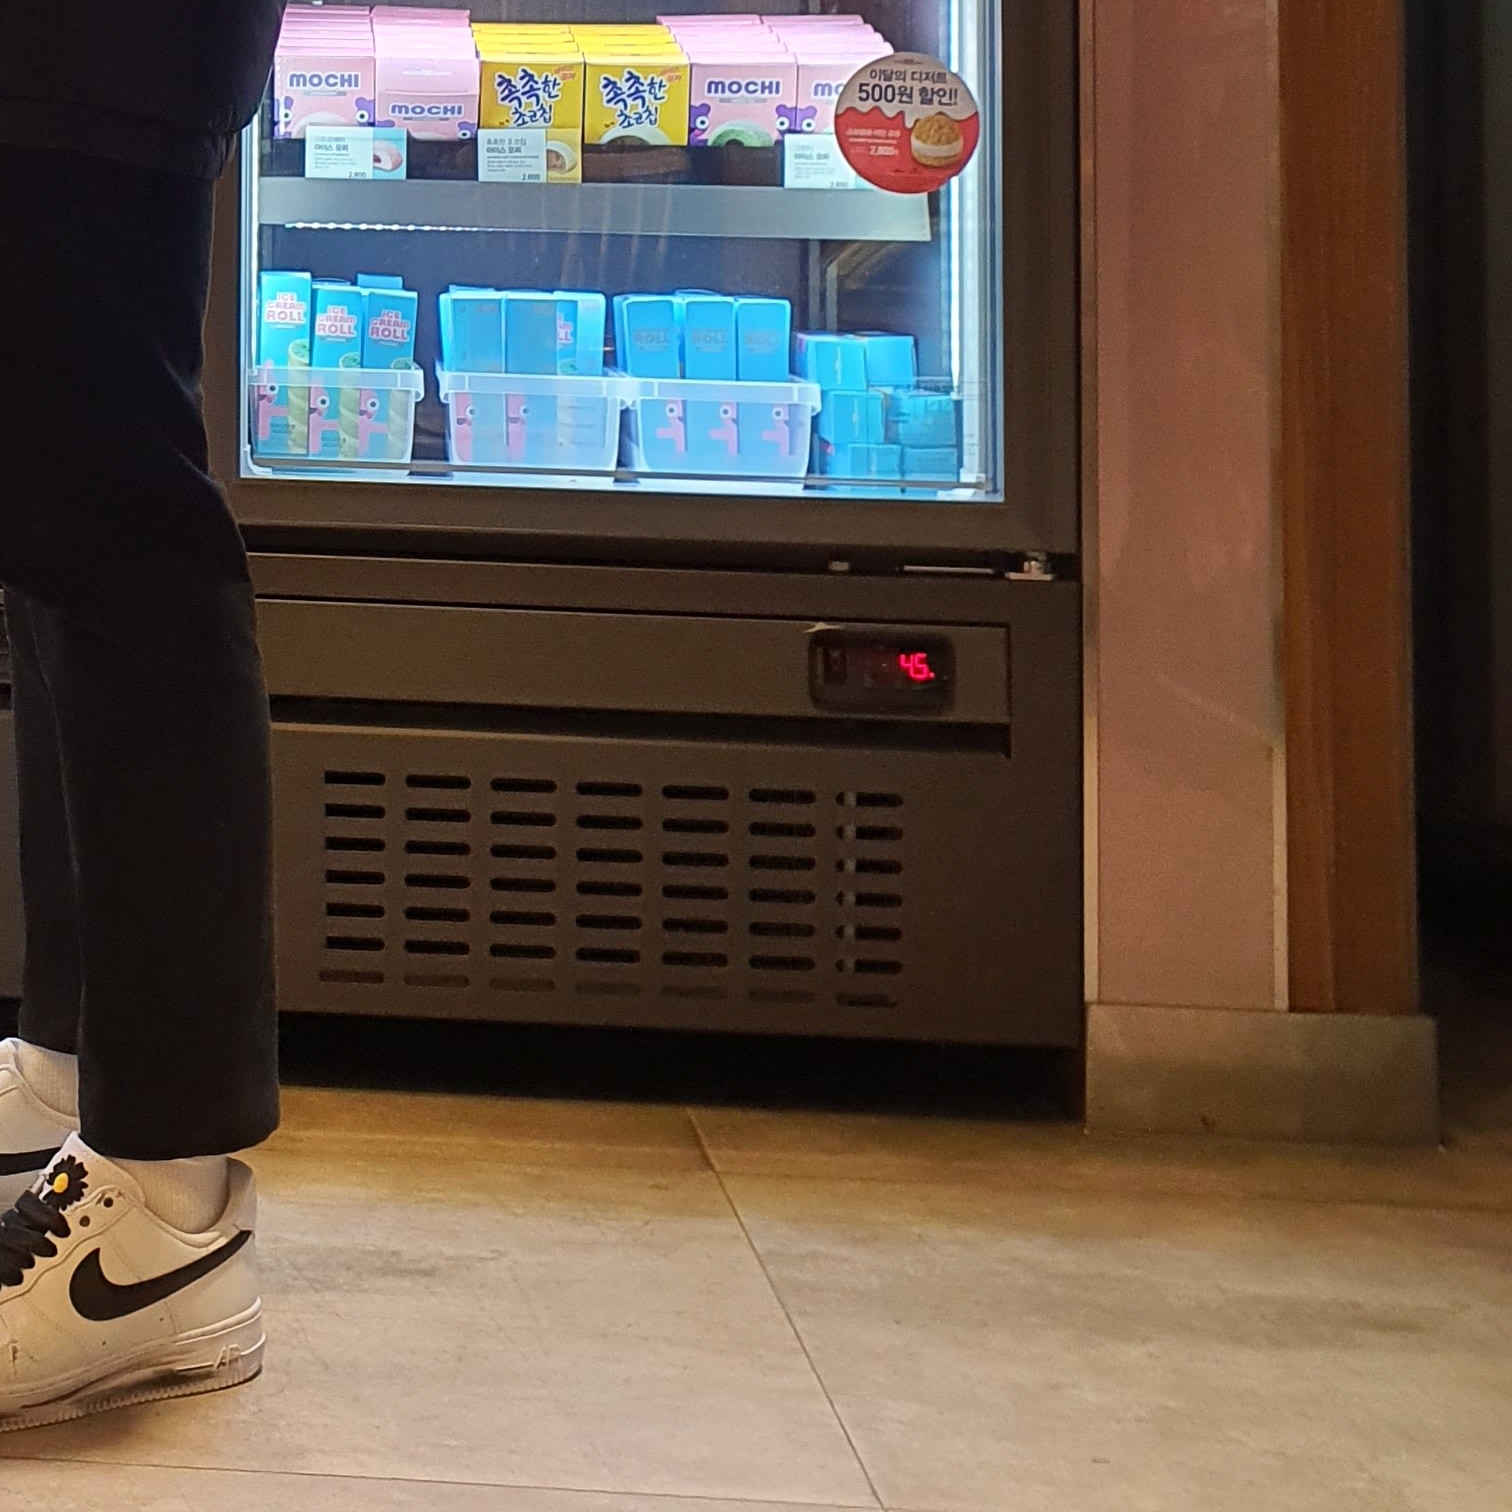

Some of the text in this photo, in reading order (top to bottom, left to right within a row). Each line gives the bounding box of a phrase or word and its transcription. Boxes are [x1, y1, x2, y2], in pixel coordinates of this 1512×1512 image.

[289, 73, 360, 88] MOCHI
[869, 68, 948, 84] 이달의 디저트
[495, 67, 562, 107] 촉촉한
[601, 70, 667, 110] 촉촉한
[706, 79, 781, 95] MOCHI
[858, 82, 914, 105] 500원
[918, 86, 958, 107] 할인!
[390, 103, 464, 116] MOCHI
[511, 104, 553, 128] 초코칩
[616, 105, 658, 129] 초코칩
[277, 293, 296, 301] ICE
[267, 302, 305, 310] CREAM
[328, 306, 346, 315] ICE
[266, 310, 304, 322] ROLL
[319, 315, 355, 324] CREAM
[382, 311, 400, 319] ICE
[317, 323, 355, 335] ROLL
[371, 318, 408, 328] CREAM
[370, 326, 408, 340] ROLL
